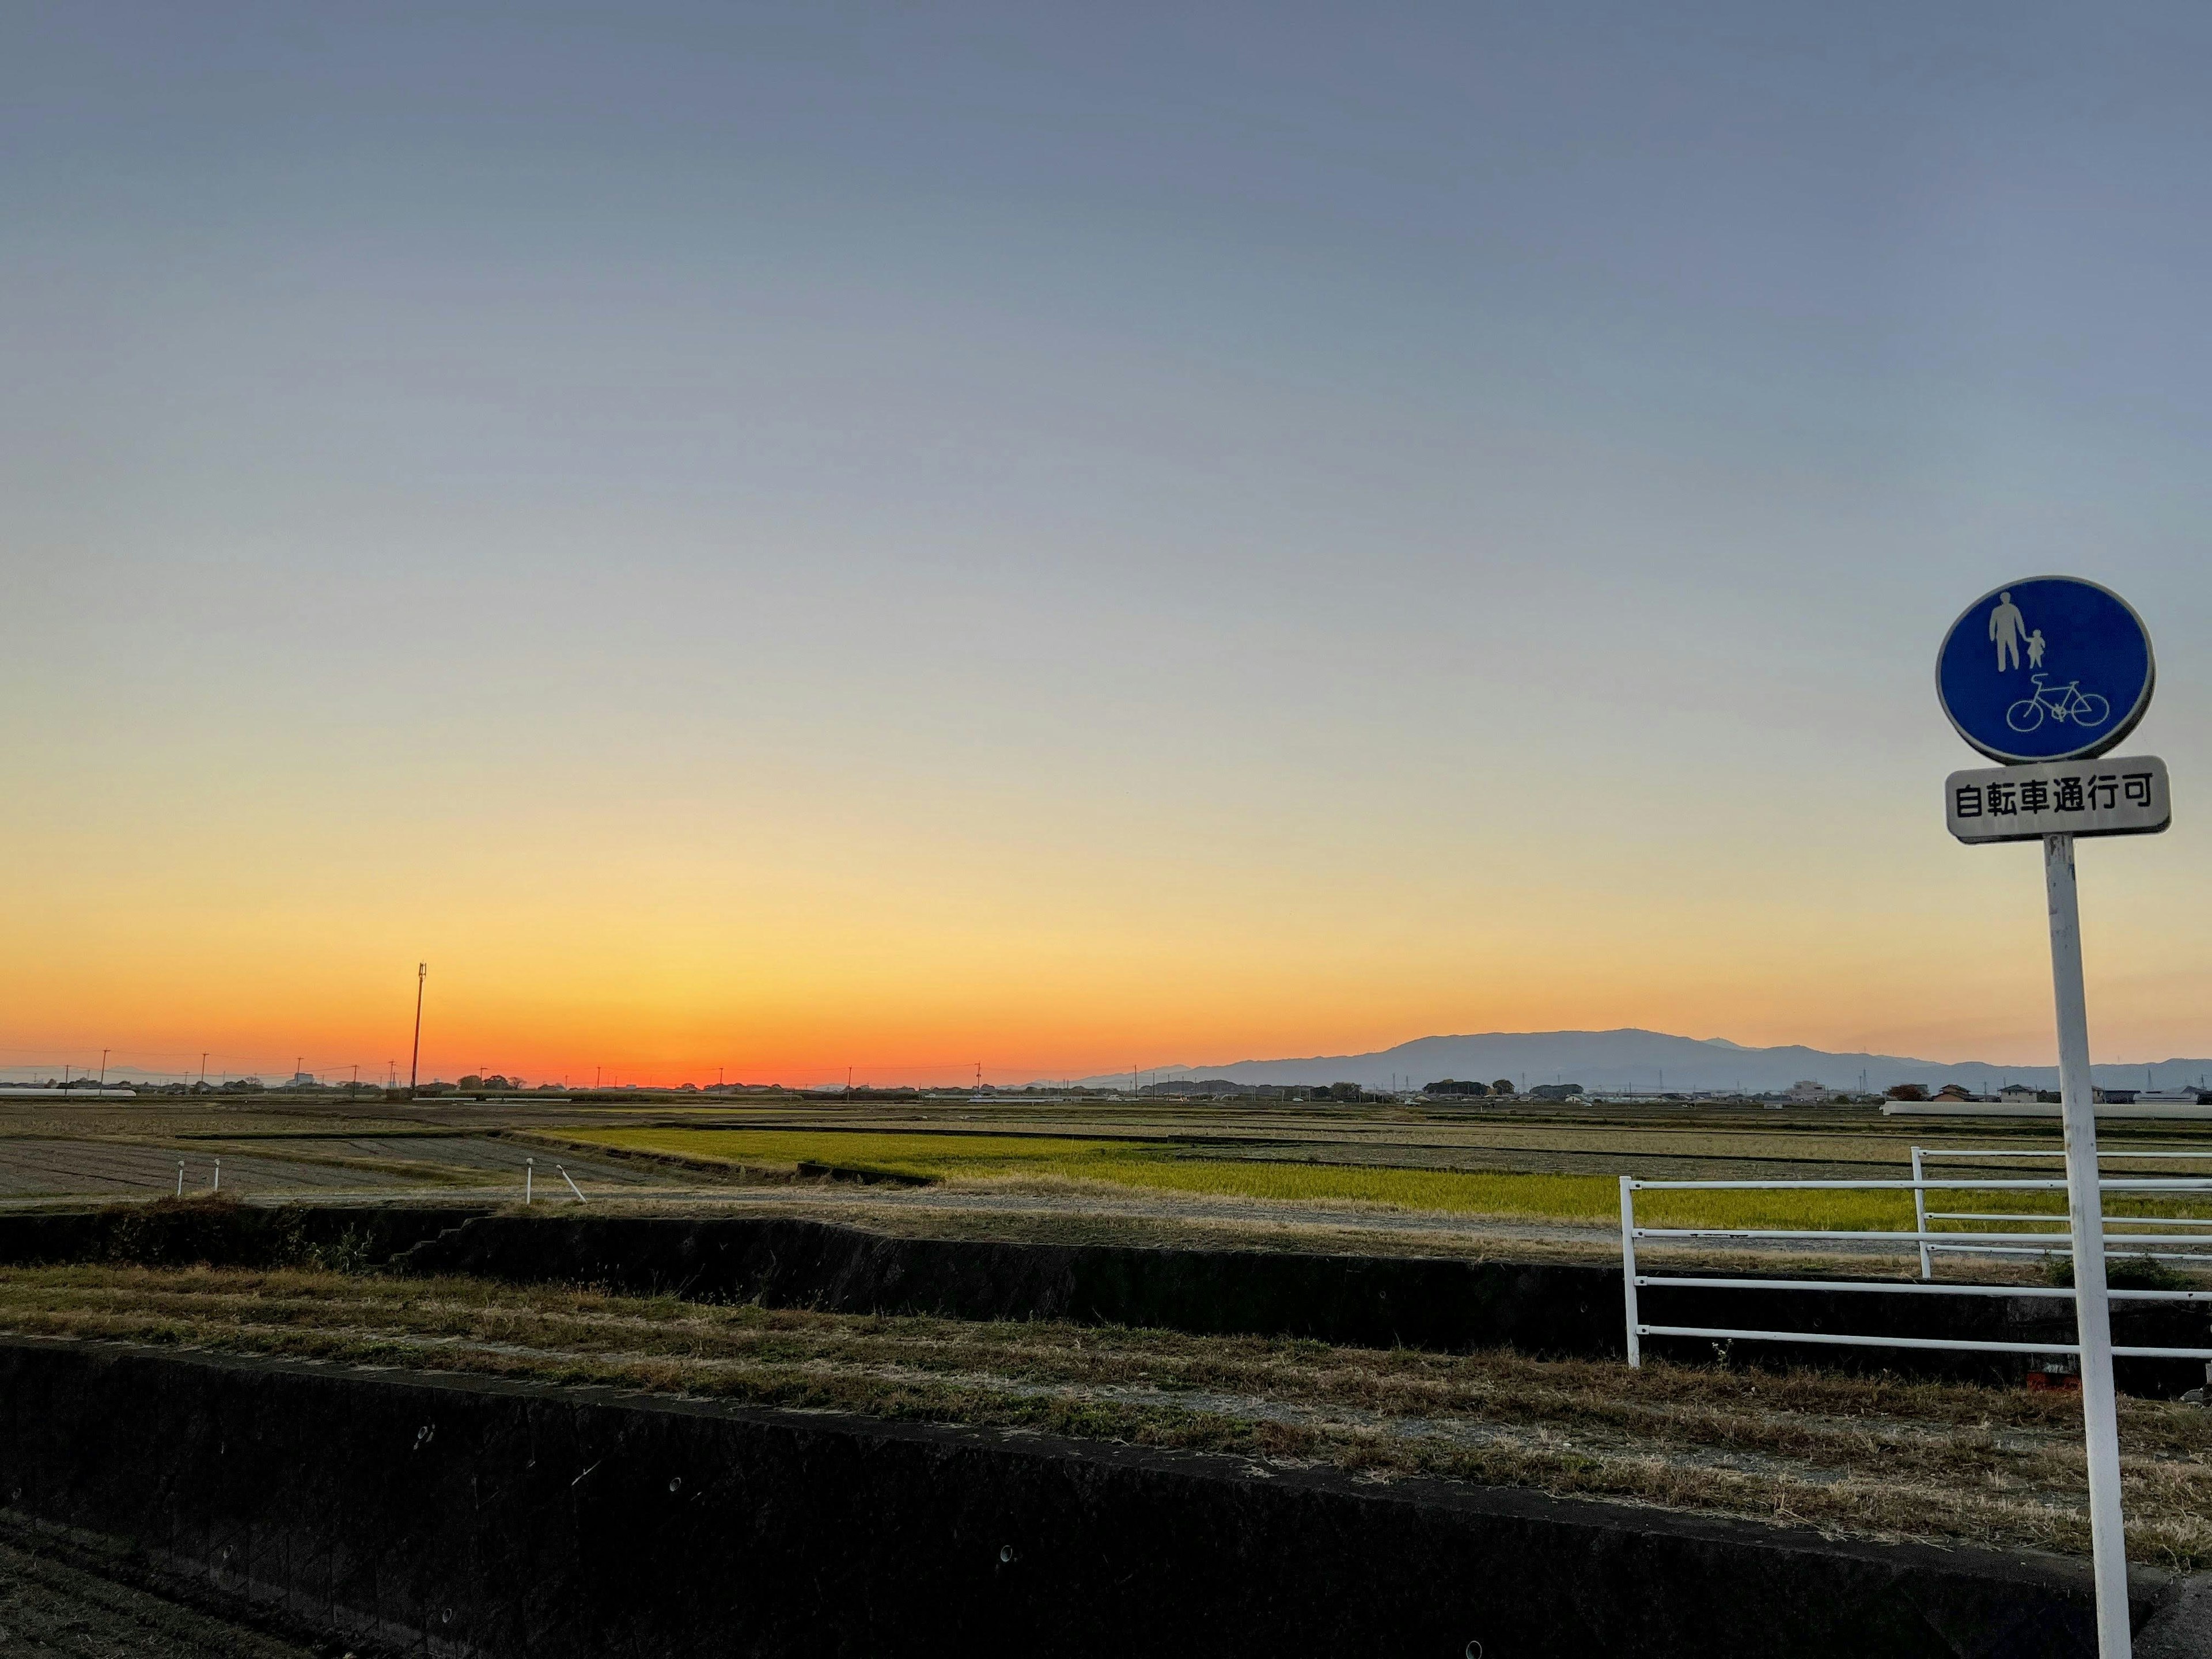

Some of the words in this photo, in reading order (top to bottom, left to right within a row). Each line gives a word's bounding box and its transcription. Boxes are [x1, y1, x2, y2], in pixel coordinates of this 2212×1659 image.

[1956, 772, 2153, 818] 自転車通行可
